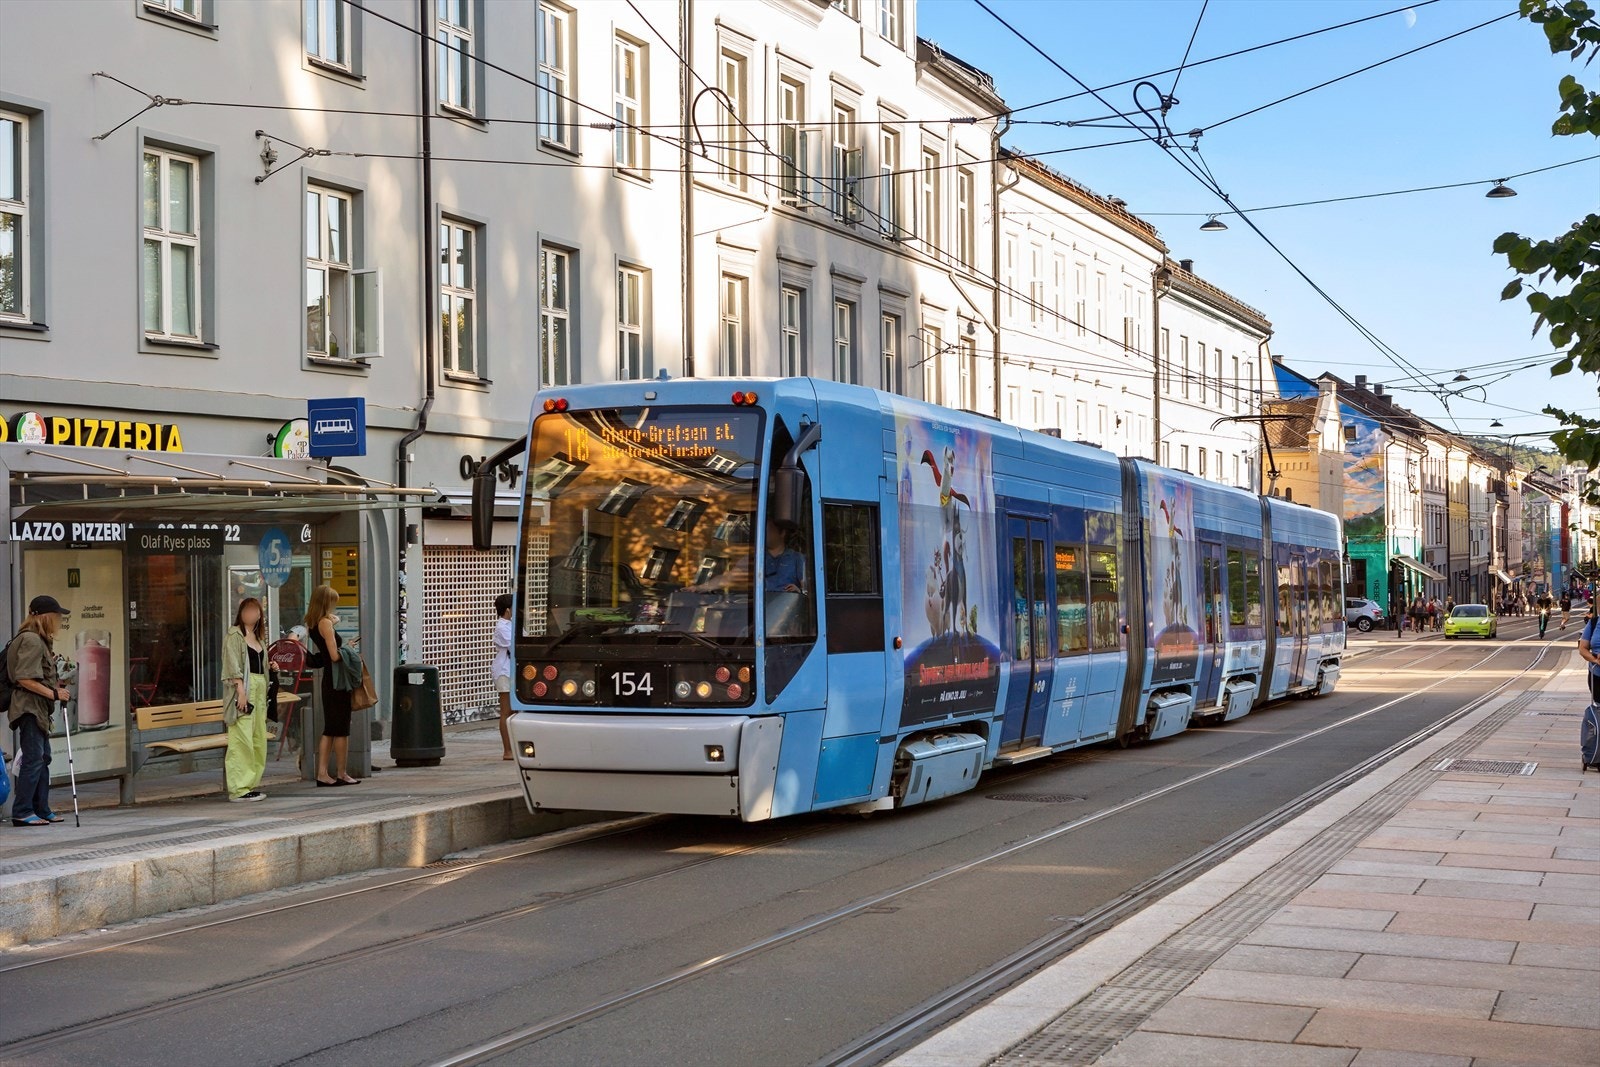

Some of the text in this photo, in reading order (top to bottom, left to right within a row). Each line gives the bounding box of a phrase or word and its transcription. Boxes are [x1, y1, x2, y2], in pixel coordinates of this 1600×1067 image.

[53, 416, 183, 452] PIZZERIA
[564, 428, 589, 461] 18
[10, 522, 65, 541] LAZZO
[225, 524, 240, 541] 22
[141, 535, 211, 551] Olaf Ryes plass
[269, 539, 281, 566] 5
[611, 672, 653, 695] 154
